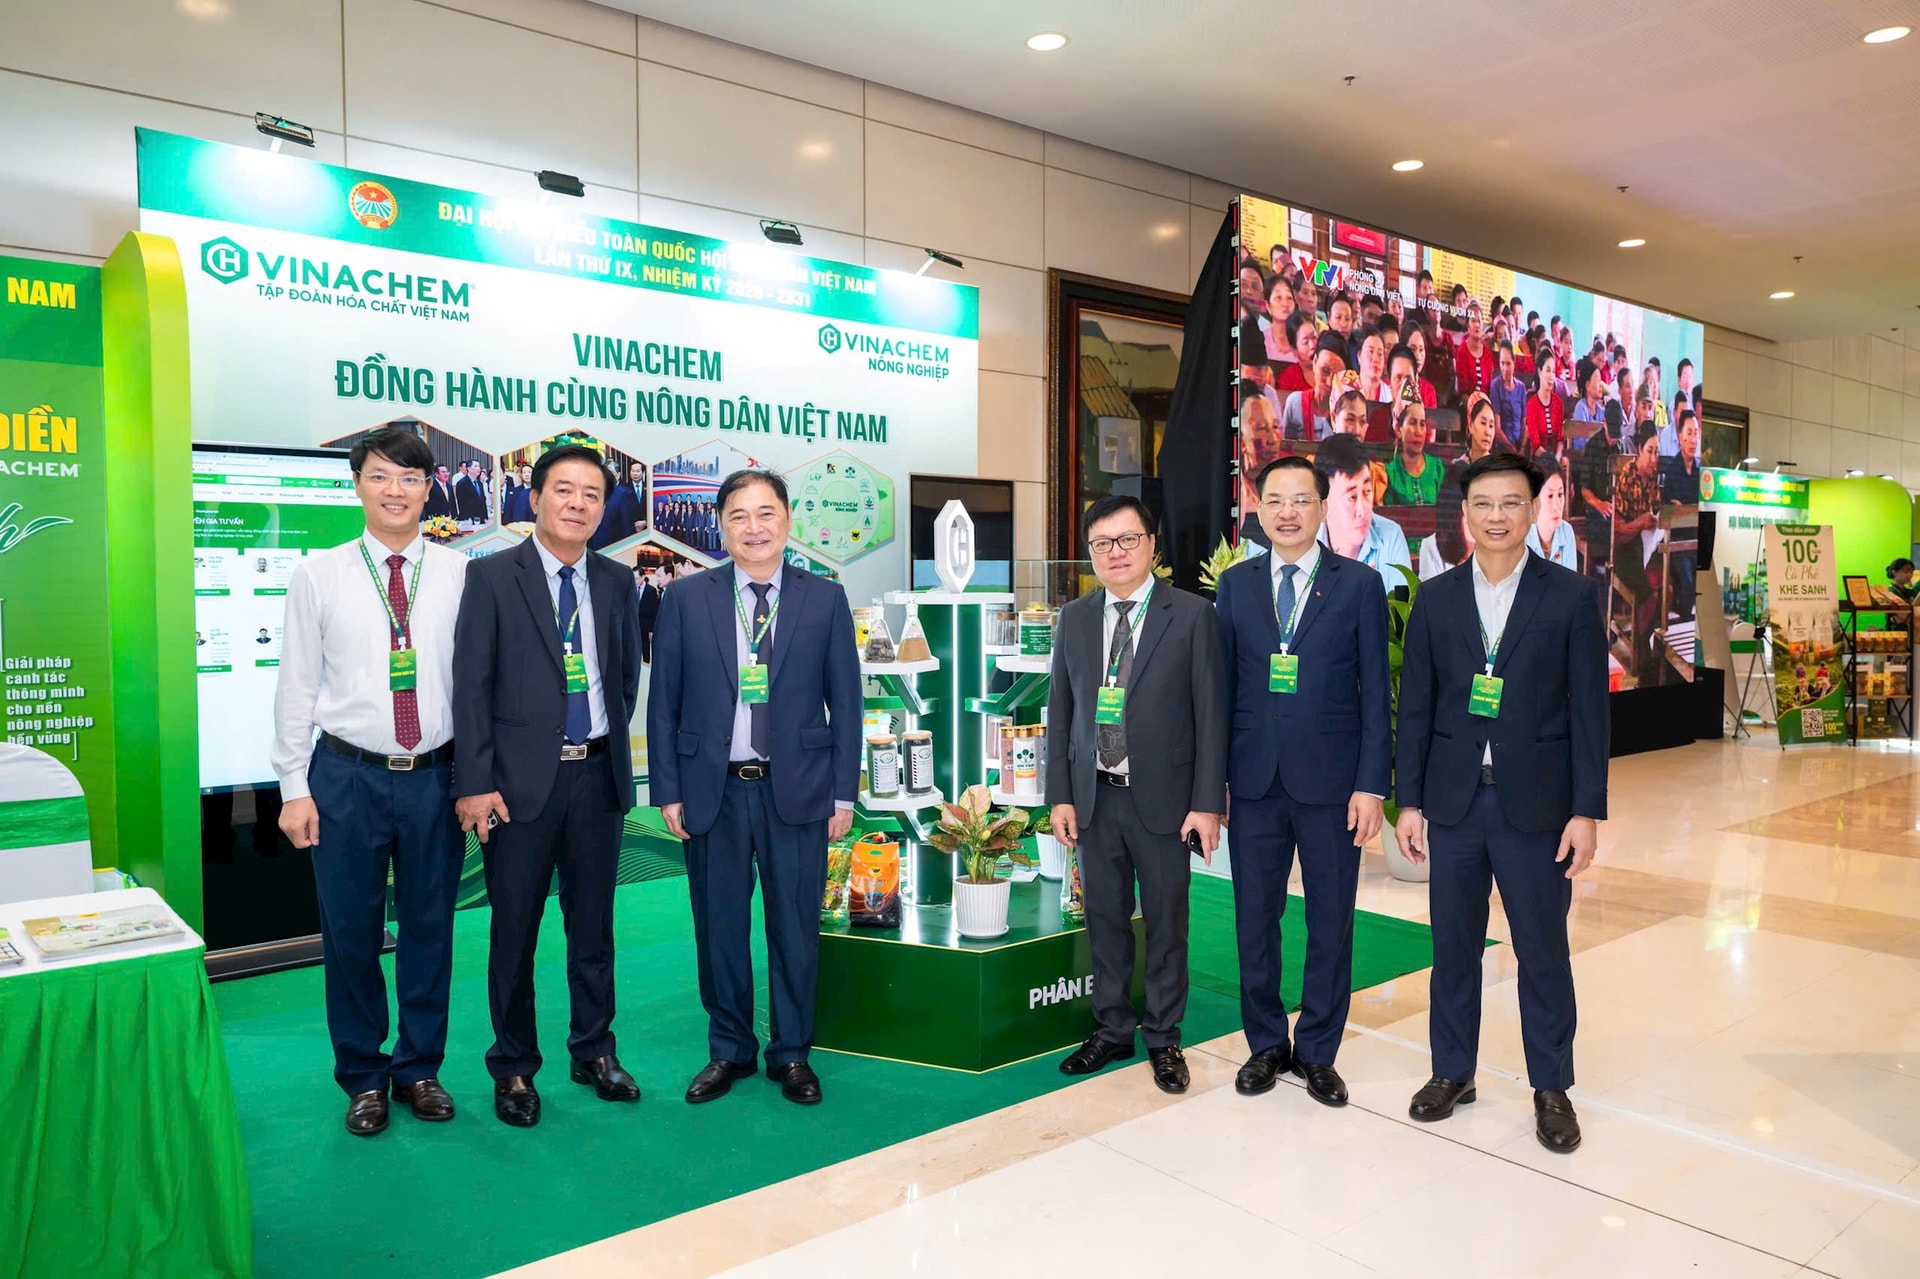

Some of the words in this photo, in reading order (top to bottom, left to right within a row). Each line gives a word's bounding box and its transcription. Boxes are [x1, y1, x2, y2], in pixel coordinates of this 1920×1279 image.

[438, 202, 473, 226] ĐẠI
[601, 231, 647, 256] TOÀN
[652, 239, 696, 264] QUỐC
[701, 249, 727, 271] HỘI
[811, 269, 843, 291] VIỆT
[844, 278, 877, 296] NAM
[256, 251, 469, 307] VINACHEM
[576, 252, 612, 275] THỨ
[615, 262, 638, 281] IX,
[643, 265, 697, 290] NHIỆM
[701, 274, 721, 293] KỲ
[1299, 256, 1344, 291] VTV1
[1349, 268, 1374, 283] PHÓNG
[7, 277, 76, 309] NAM
[1349, 281, 1371, 295] NÔNG
[257, 283, 284, 300] TẬP
[289, 290, 332, 305] ĐOÀN
[336, 294, 367, 310] HÓA
[371, 300, 407, 314] CHẤT
[411, 305, 438, 320] VIỆT
[442, 310, 470, 323] NAM
[573, 333, 722, 382] VINACHEM
[845, 332, 949, 363] VINACHEM
[868, 356, 904, 374] NÔNG
[907, 363, 949, 382] NGHIỆP
[335, 353, 434, 404] ĐỒNG
[446, 367, 536, 413] HÀNH
[547, 376, 627, 421] CÙNG
[636, 386, 710, 428] NÔNG
[719, 395, 770, 433] DÂN
[778, 402, 830, 442] VIỆT
[837, 411, 887, 443] NAM
[1779, 585, 1799, 595] KHE
[1801, 585, 1827, 595] SANH
[5, 656, 33, 669] Giải
[37, 656, 71, 669] pháp
[6, 673, 40, 685] canh
[44, 671, 66, 683] tác
[6, 688, 46, 700] thông
[50, 686, 85, 698] minh
[6, 704, 32, 715] cho
[7, 718, 42, 731] nông
[46, 715, 93, 729] nghiệp
[37, 731, 70, 744] vững
[1029, 976, 1081, 1009] PHÂN
